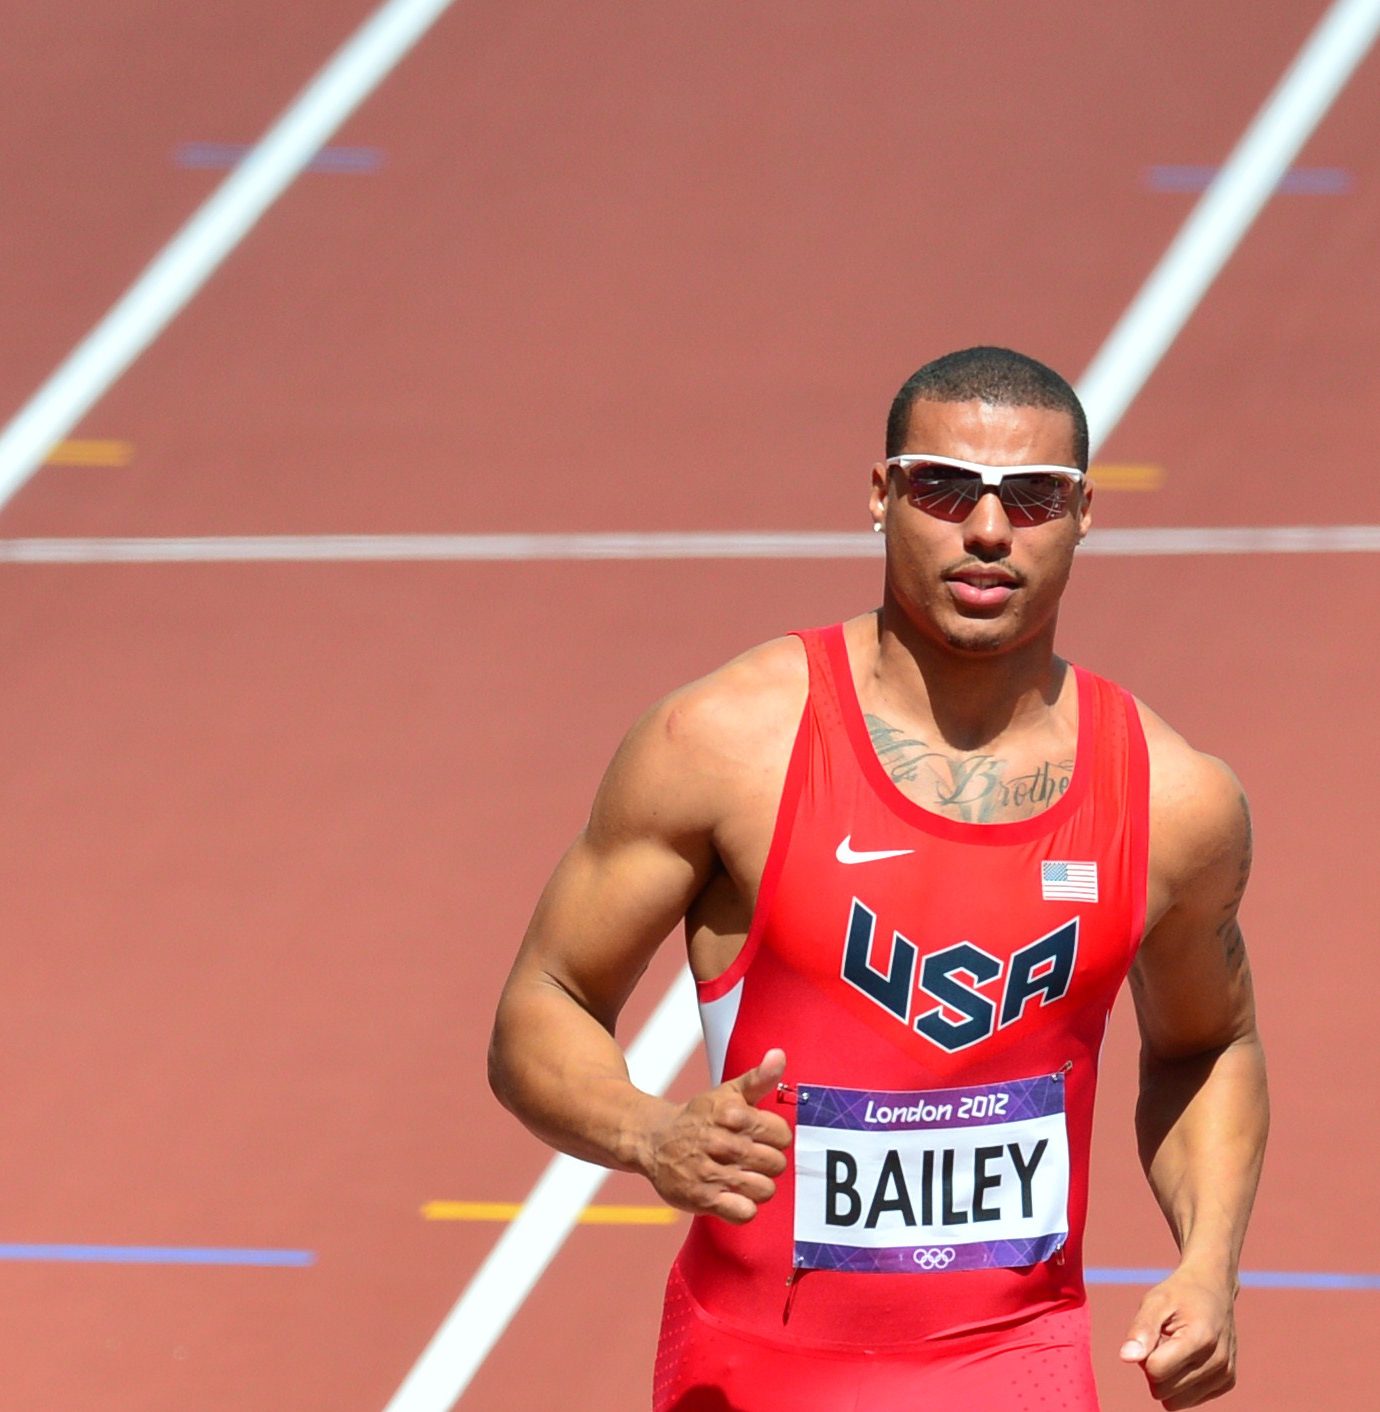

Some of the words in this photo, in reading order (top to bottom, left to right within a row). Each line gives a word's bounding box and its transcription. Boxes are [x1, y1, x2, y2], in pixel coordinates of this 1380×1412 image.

[840, 896, 1080, 1054] USA
[863, 1097, 954, 1126] London
[957, 1093, 1011, 1120] 2012
[825, 1138, 1049, 1229] BAILEY
